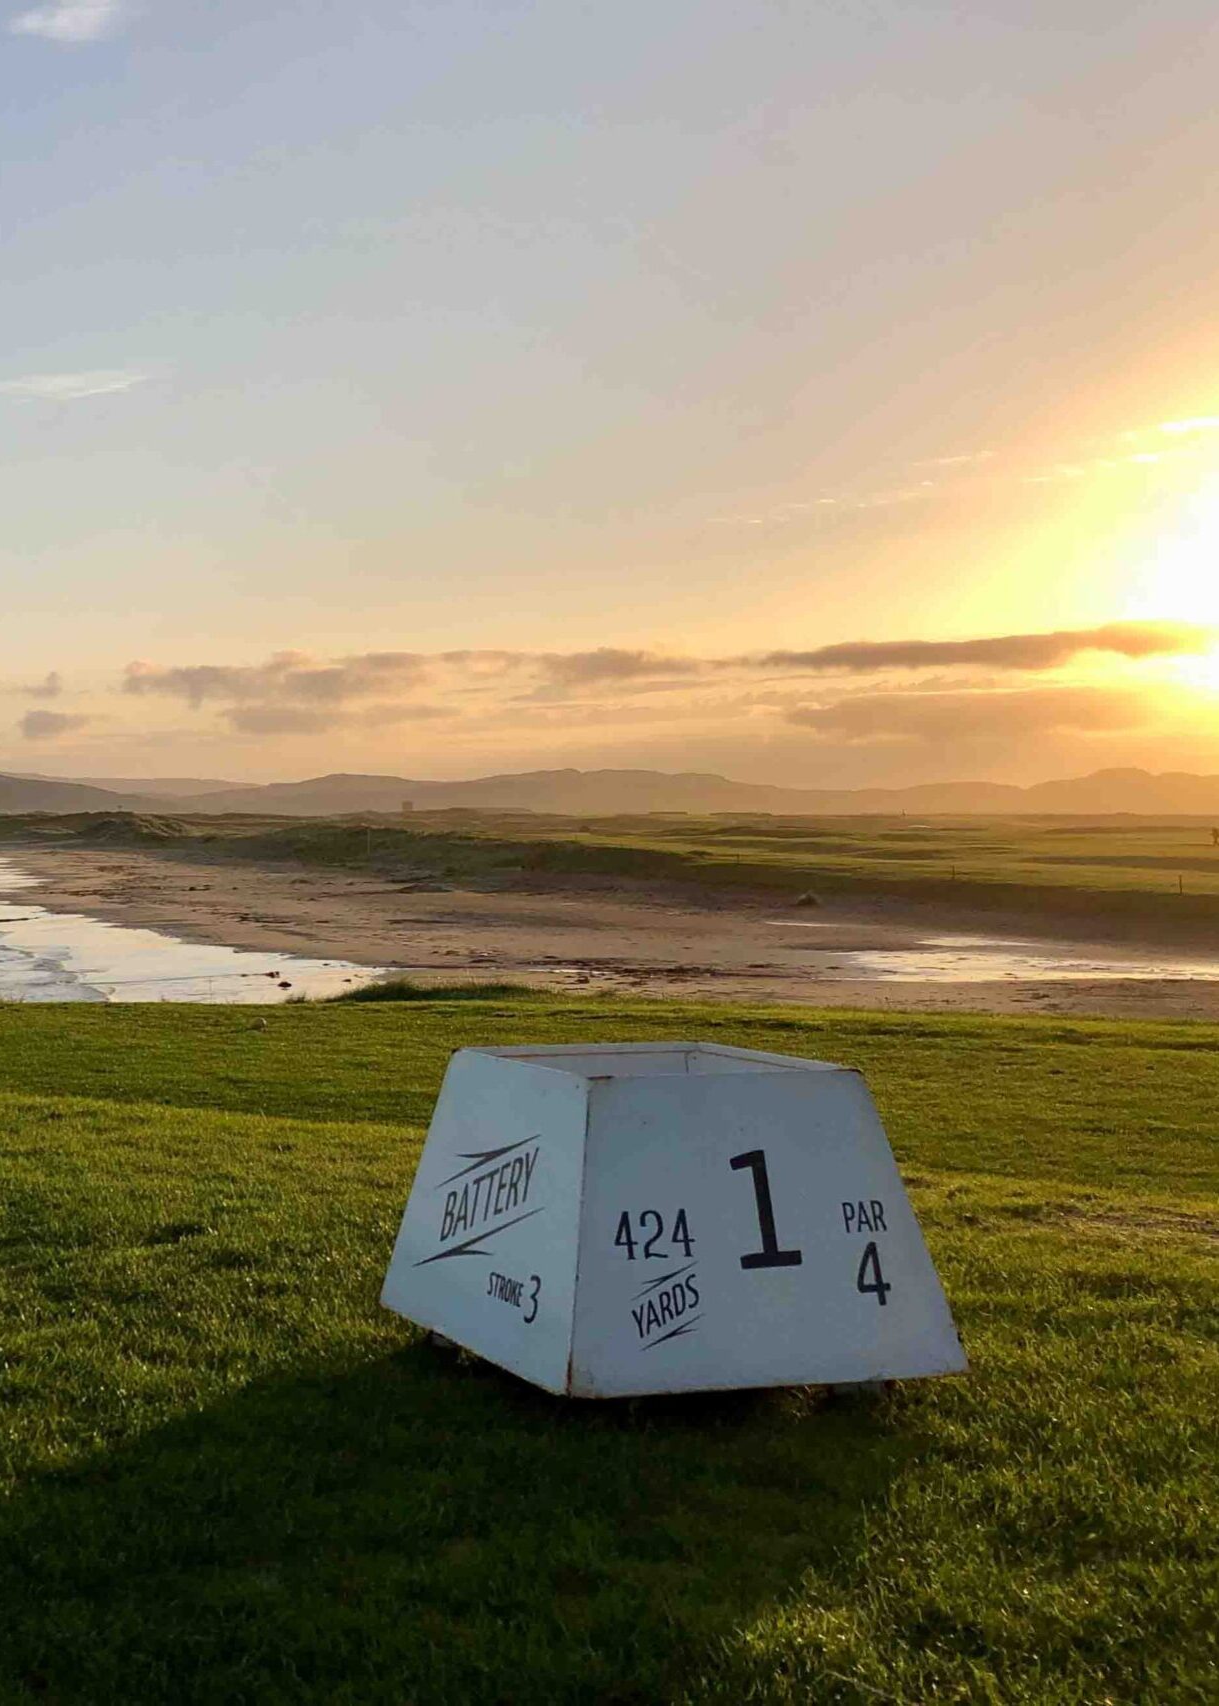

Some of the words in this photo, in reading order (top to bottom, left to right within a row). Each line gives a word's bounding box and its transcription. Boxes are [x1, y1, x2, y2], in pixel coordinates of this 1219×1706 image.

[440, 1148, 540, 1242] BATTERY
[730, 1150, 802, 1269] 1
[842, 1201, 887, 1233] PAR
[615, 1209, 696, 1260] 424
[487, 1271, 524, 1308] STROKE
[524, 1276, 541, 1324] 3
[858, 1242, 892, 1306] 4
[632, 1274, 700, 1339] YARDS
